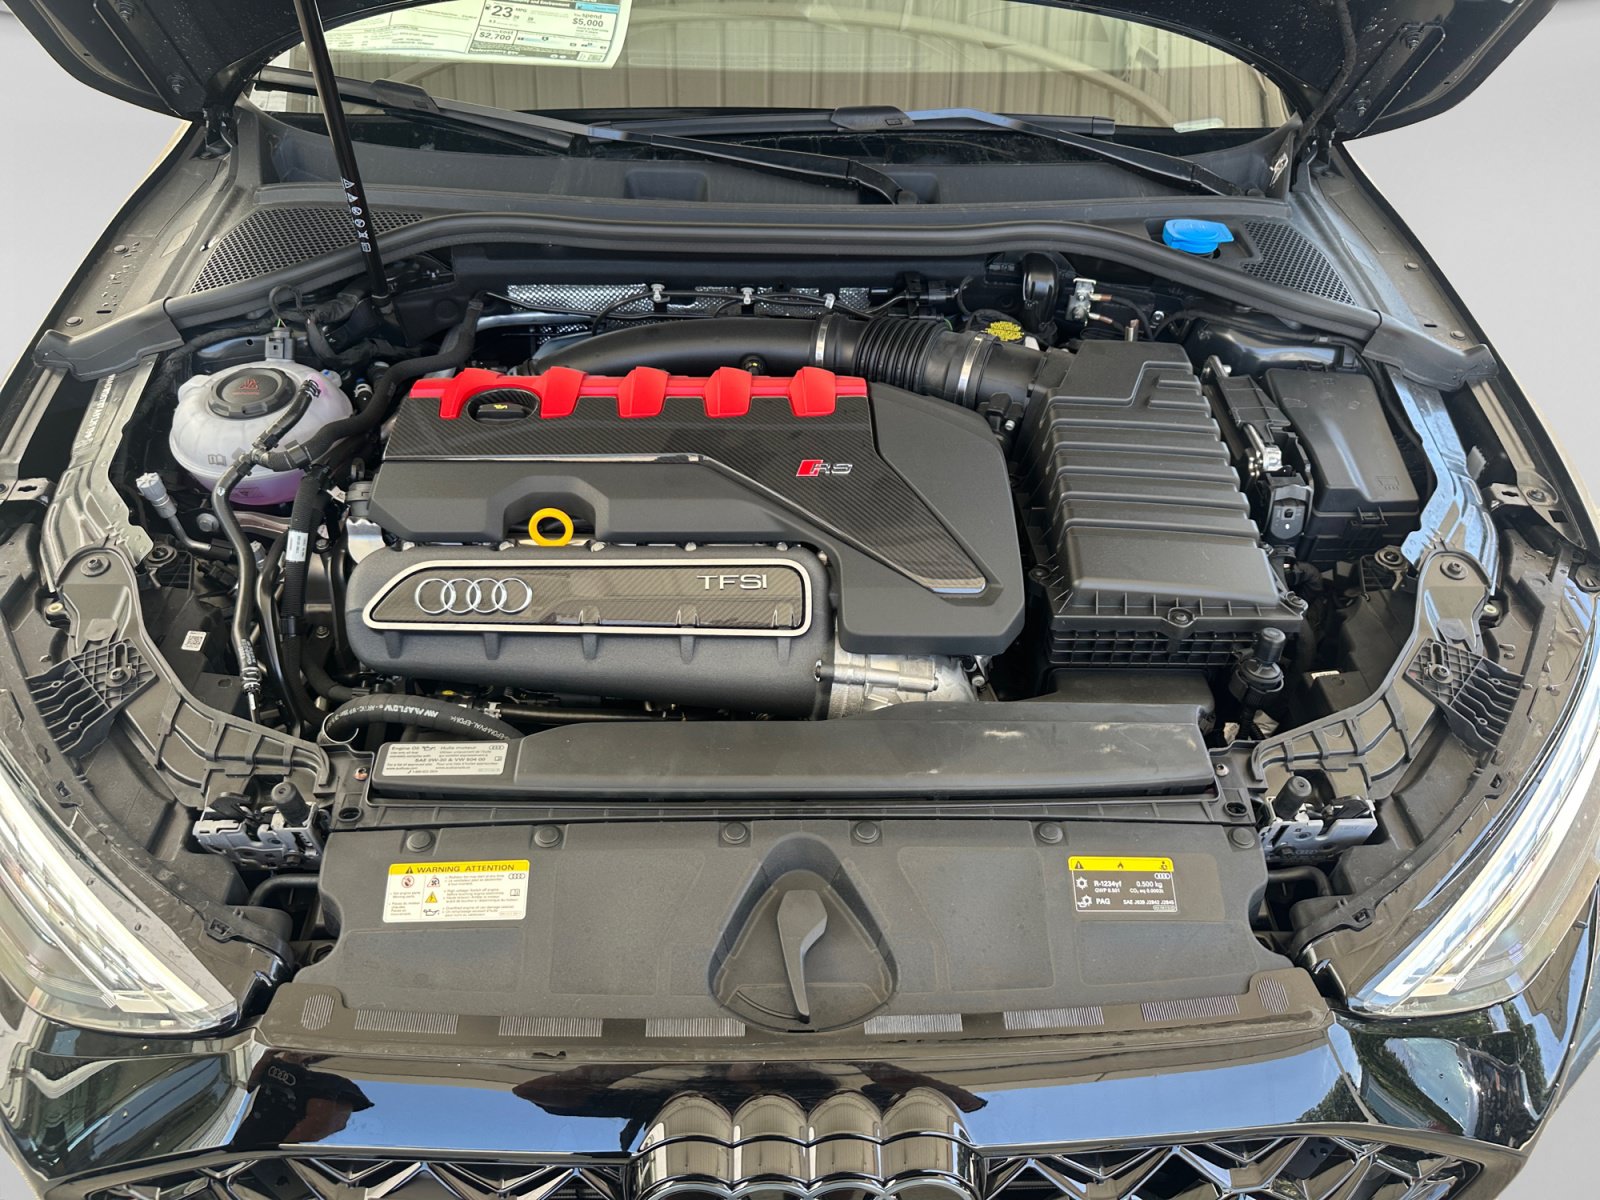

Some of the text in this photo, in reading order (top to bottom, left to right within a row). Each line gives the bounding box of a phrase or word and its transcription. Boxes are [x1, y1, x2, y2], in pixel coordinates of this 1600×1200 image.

[491, 5, 513, 17] 23
[572, 18, 604, 27] $5,000
[480, 32, 511, 40] $2,700
[808, 462, 853, 475] RS
[696, 574, 767, 590] TFSI
[465, 864, 514, 872] ATTENTION
[1093, 880, 1122, 888] R-1234yf
